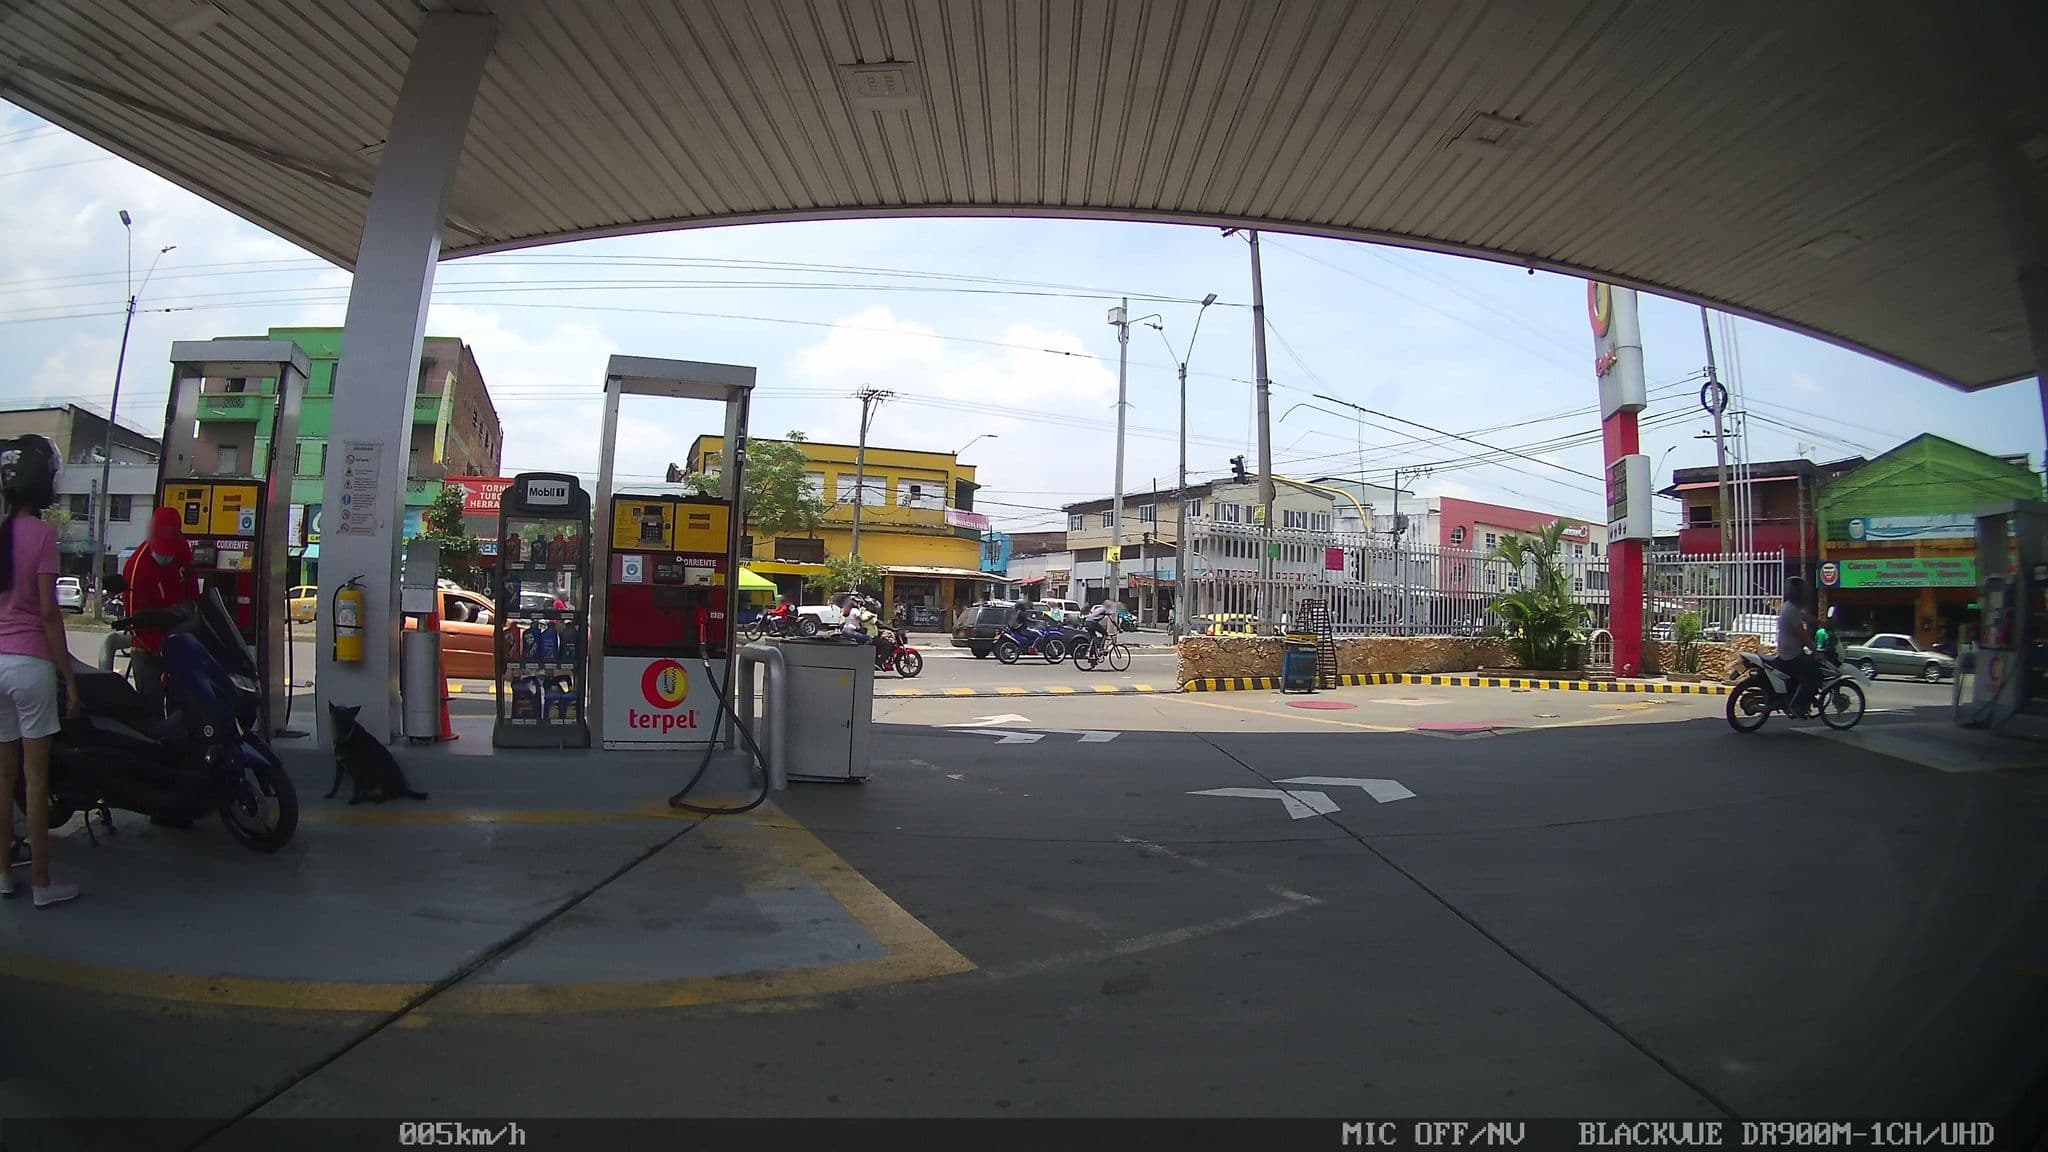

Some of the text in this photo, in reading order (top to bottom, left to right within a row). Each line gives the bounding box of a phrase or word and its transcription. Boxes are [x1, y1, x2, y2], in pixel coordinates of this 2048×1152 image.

[529, 487, 555, 497] Mobil
[216, 540, 249, 550] CORRIENTE
[683, 558, 717, 567] ORRIENTE
[629, 709, 697, 734] terpel
